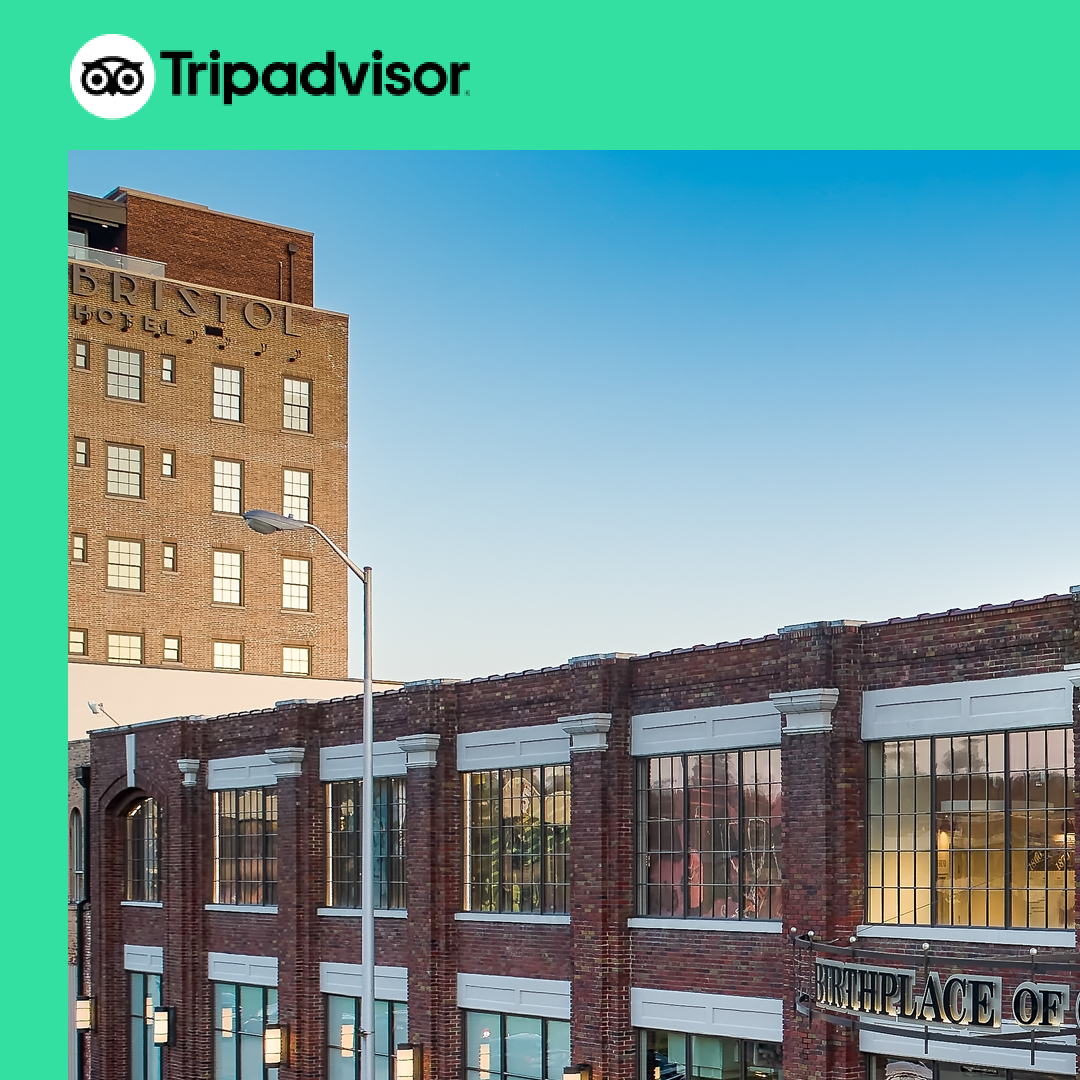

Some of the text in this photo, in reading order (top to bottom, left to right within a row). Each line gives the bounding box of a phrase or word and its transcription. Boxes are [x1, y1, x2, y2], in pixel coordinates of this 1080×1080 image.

[72, 262, 301, 338] BRISTOL
[74, 303, 176, 336] HOTEL
[814, 960, 997, 1028] BIRTHPLACE
[1014, 987, 1064, 1027] OF
